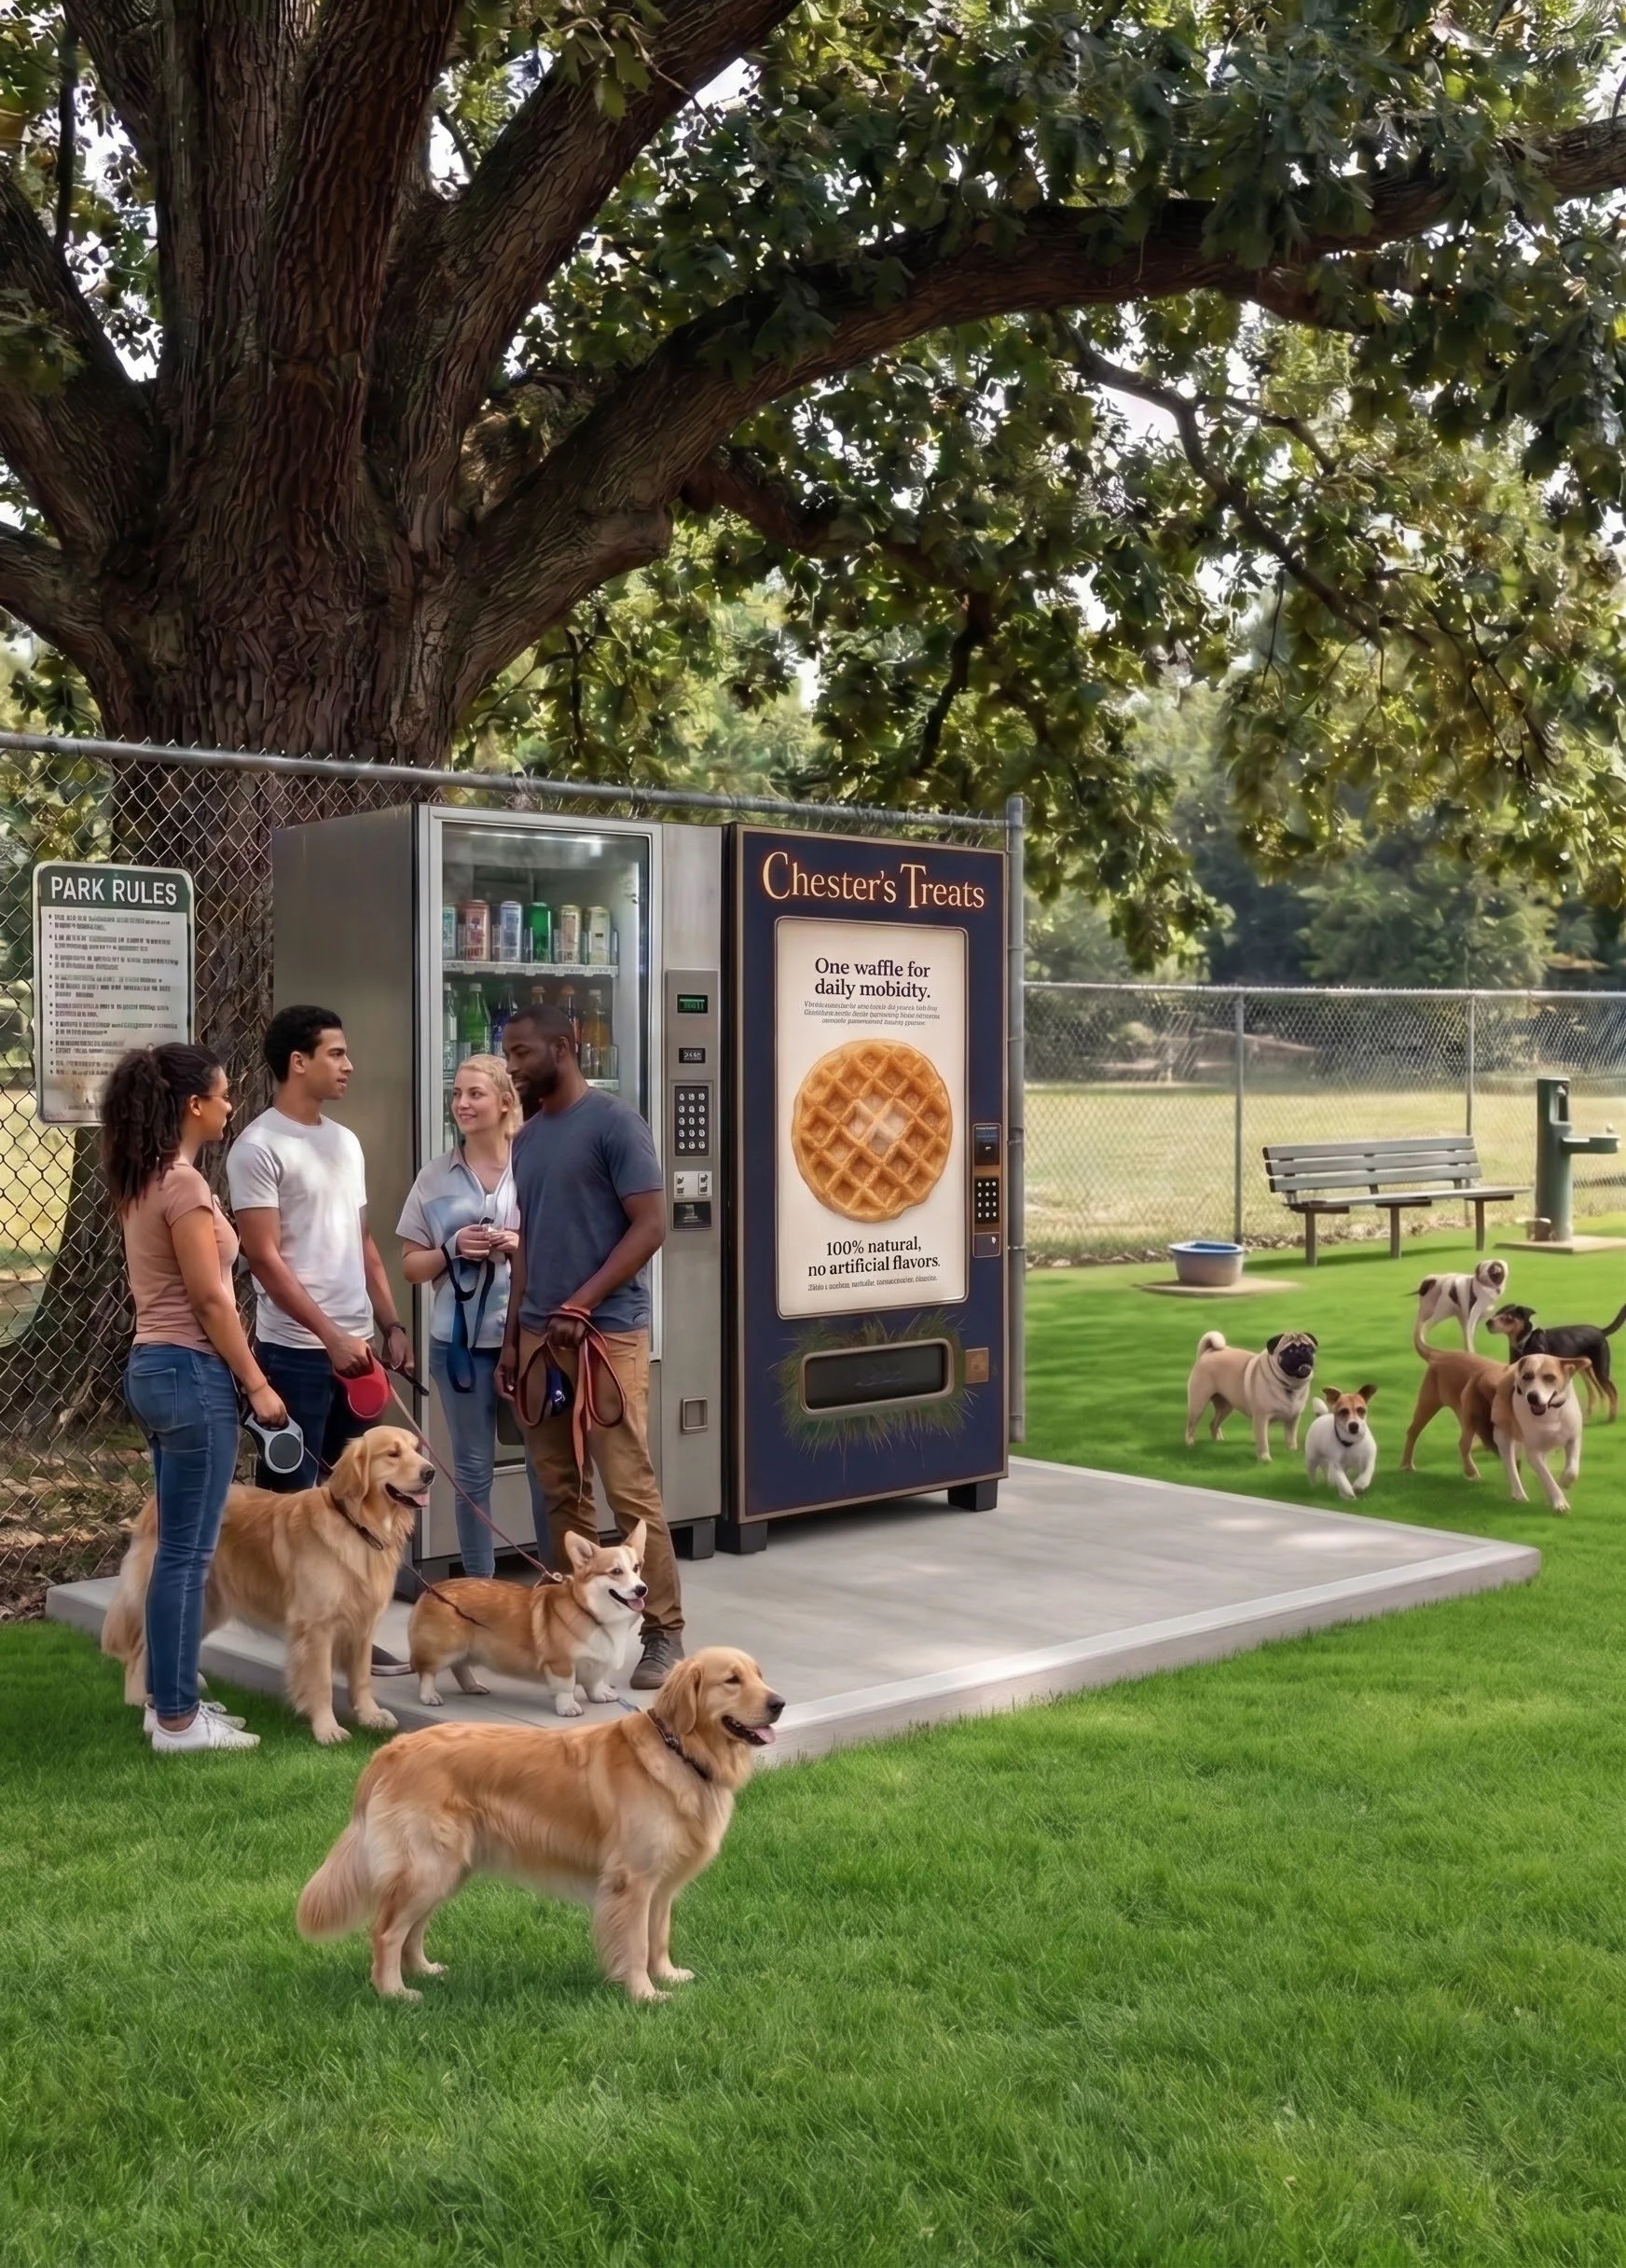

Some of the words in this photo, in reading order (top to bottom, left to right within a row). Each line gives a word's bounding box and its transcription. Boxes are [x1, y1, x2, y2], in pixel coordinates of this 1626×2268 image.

[762, 851, 897, 903] Chester's
[900, 864, 985, 908] Treats
[51, 876, 105, 901] PARK
[113, 879, 177, 906] RULES
[815, 958, 849, 975] One
[854, 960, 903, 977] waffle
[907, 961, 930, 977] for
[815, 978, 856, 1000] daily
[826, 1239, 864, 1256] 100%
[868, 1236, 921, 1253] natural,
[808, 1265, 826, 1277] no
[830, 1256, 889, 1275] artificial
[893, 1255, 940, 1269] flavors.
